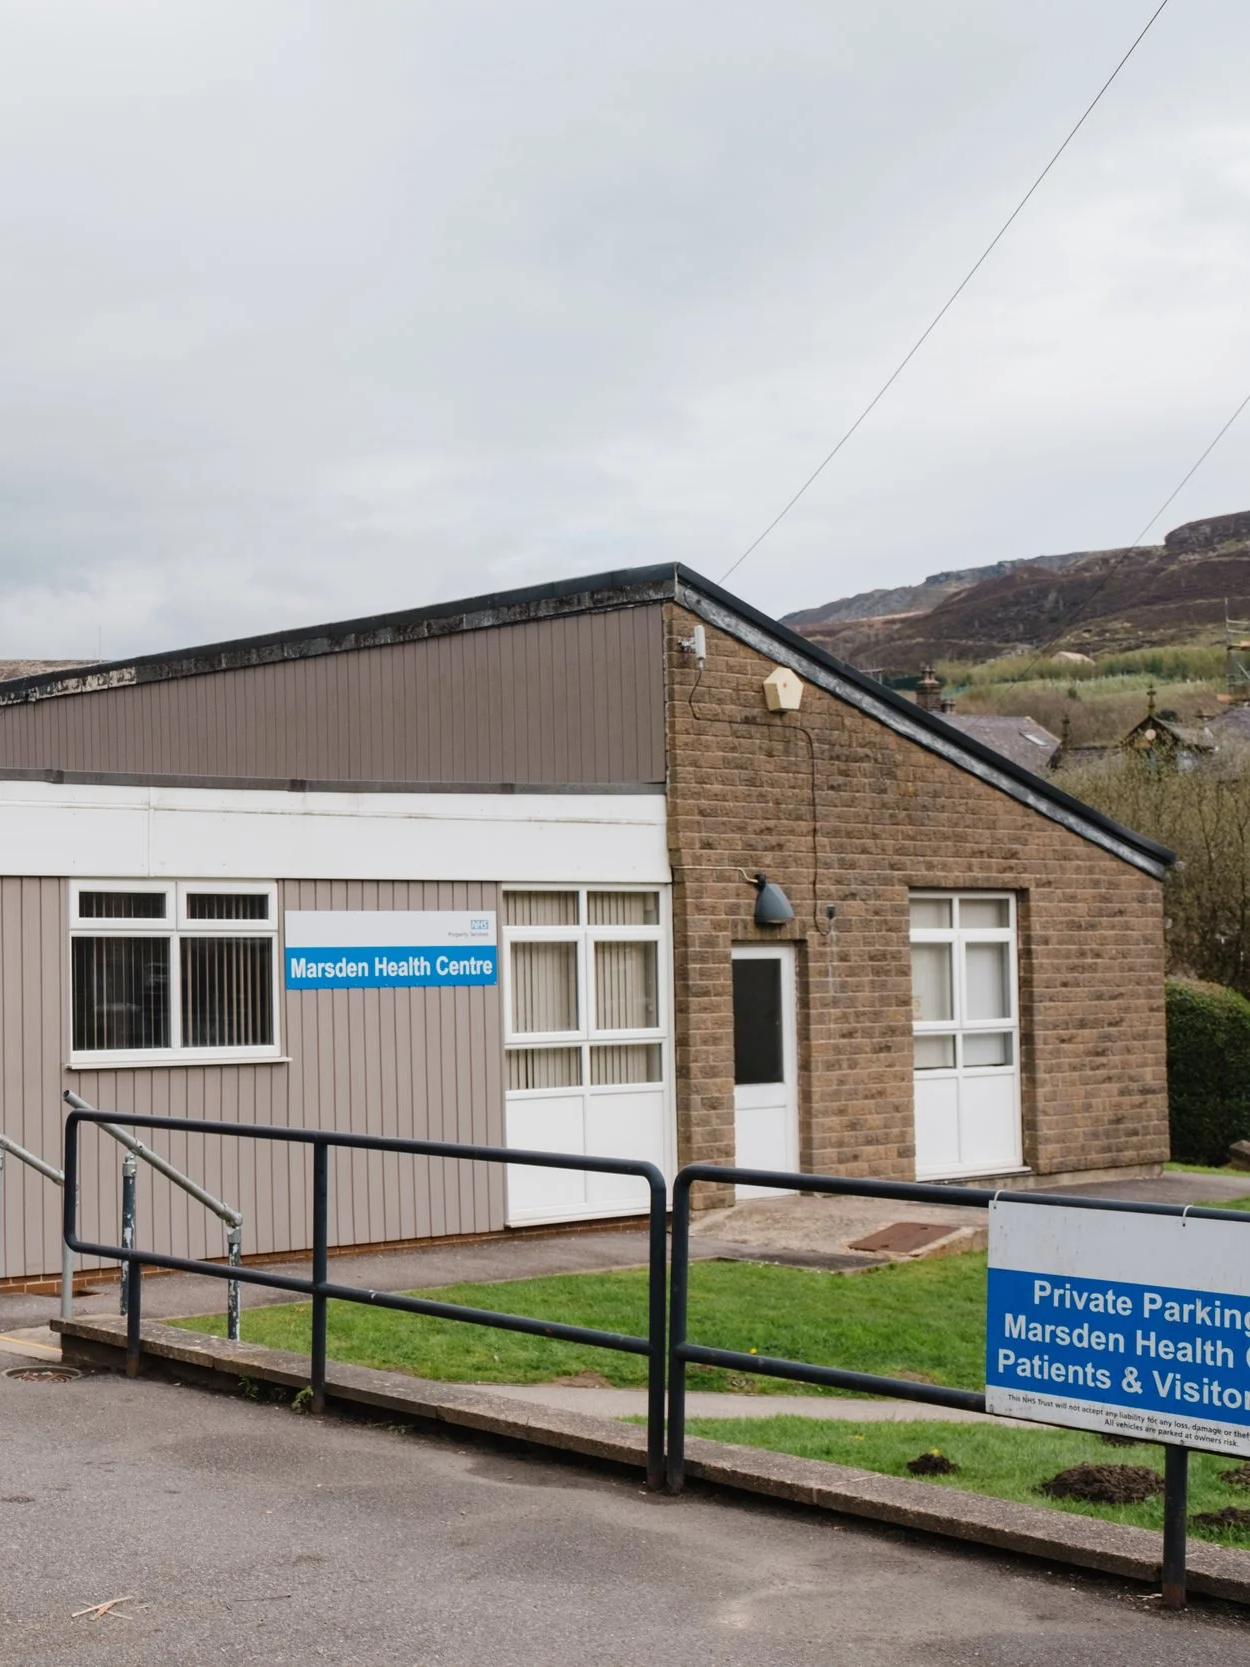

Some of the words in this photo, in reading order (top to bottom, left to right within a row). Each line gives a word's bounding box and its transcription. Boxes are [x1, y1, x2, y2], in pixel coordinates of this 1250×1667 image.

[471, 920, 489, 930] NHS
[291, 957, 369, 979] Marsden
[375, 956, 431, 977] Health
[436, 955, 493, 976] Centre
[1033, 1279, 1133, 1317] Private
[1004, 1312, 1125, 1354] Marsden
[1136, 1330, 1234, 1369] Health
[997, 1348, 1112, 1390] Patients
[1121, 1366, 1143, 1395] &
[1008, 1394, 1021, 1402] This
[1022, 1396, 1036, 1404] NHS
[1037, 1399, 1053, 1408] Trust
[1055, 1401, 1067, 1409] will
[1069, 1404, 1080, 1412] not
[1081, 1406, 1104, 1416] accept
[1105, 1410, 1117, 1419] any
[1119, 1411, 1145, 1423] liability
[1147, 1416, 1158, 1424] for
[1159, 1418, 1172, 1428] any
[1191, 1424, 1222, 1436] damage
[1233, 1431, 1250, 1439] thef
[1105, 1418, 1114, 1426] All
[1115, 1421, 1143, 1431] vehicles
[1158, 1428, 1183, 1438] parked
[1194, 1435, 1222, 1444] owners
[1223, 1439, 1239, 1447] risk.
